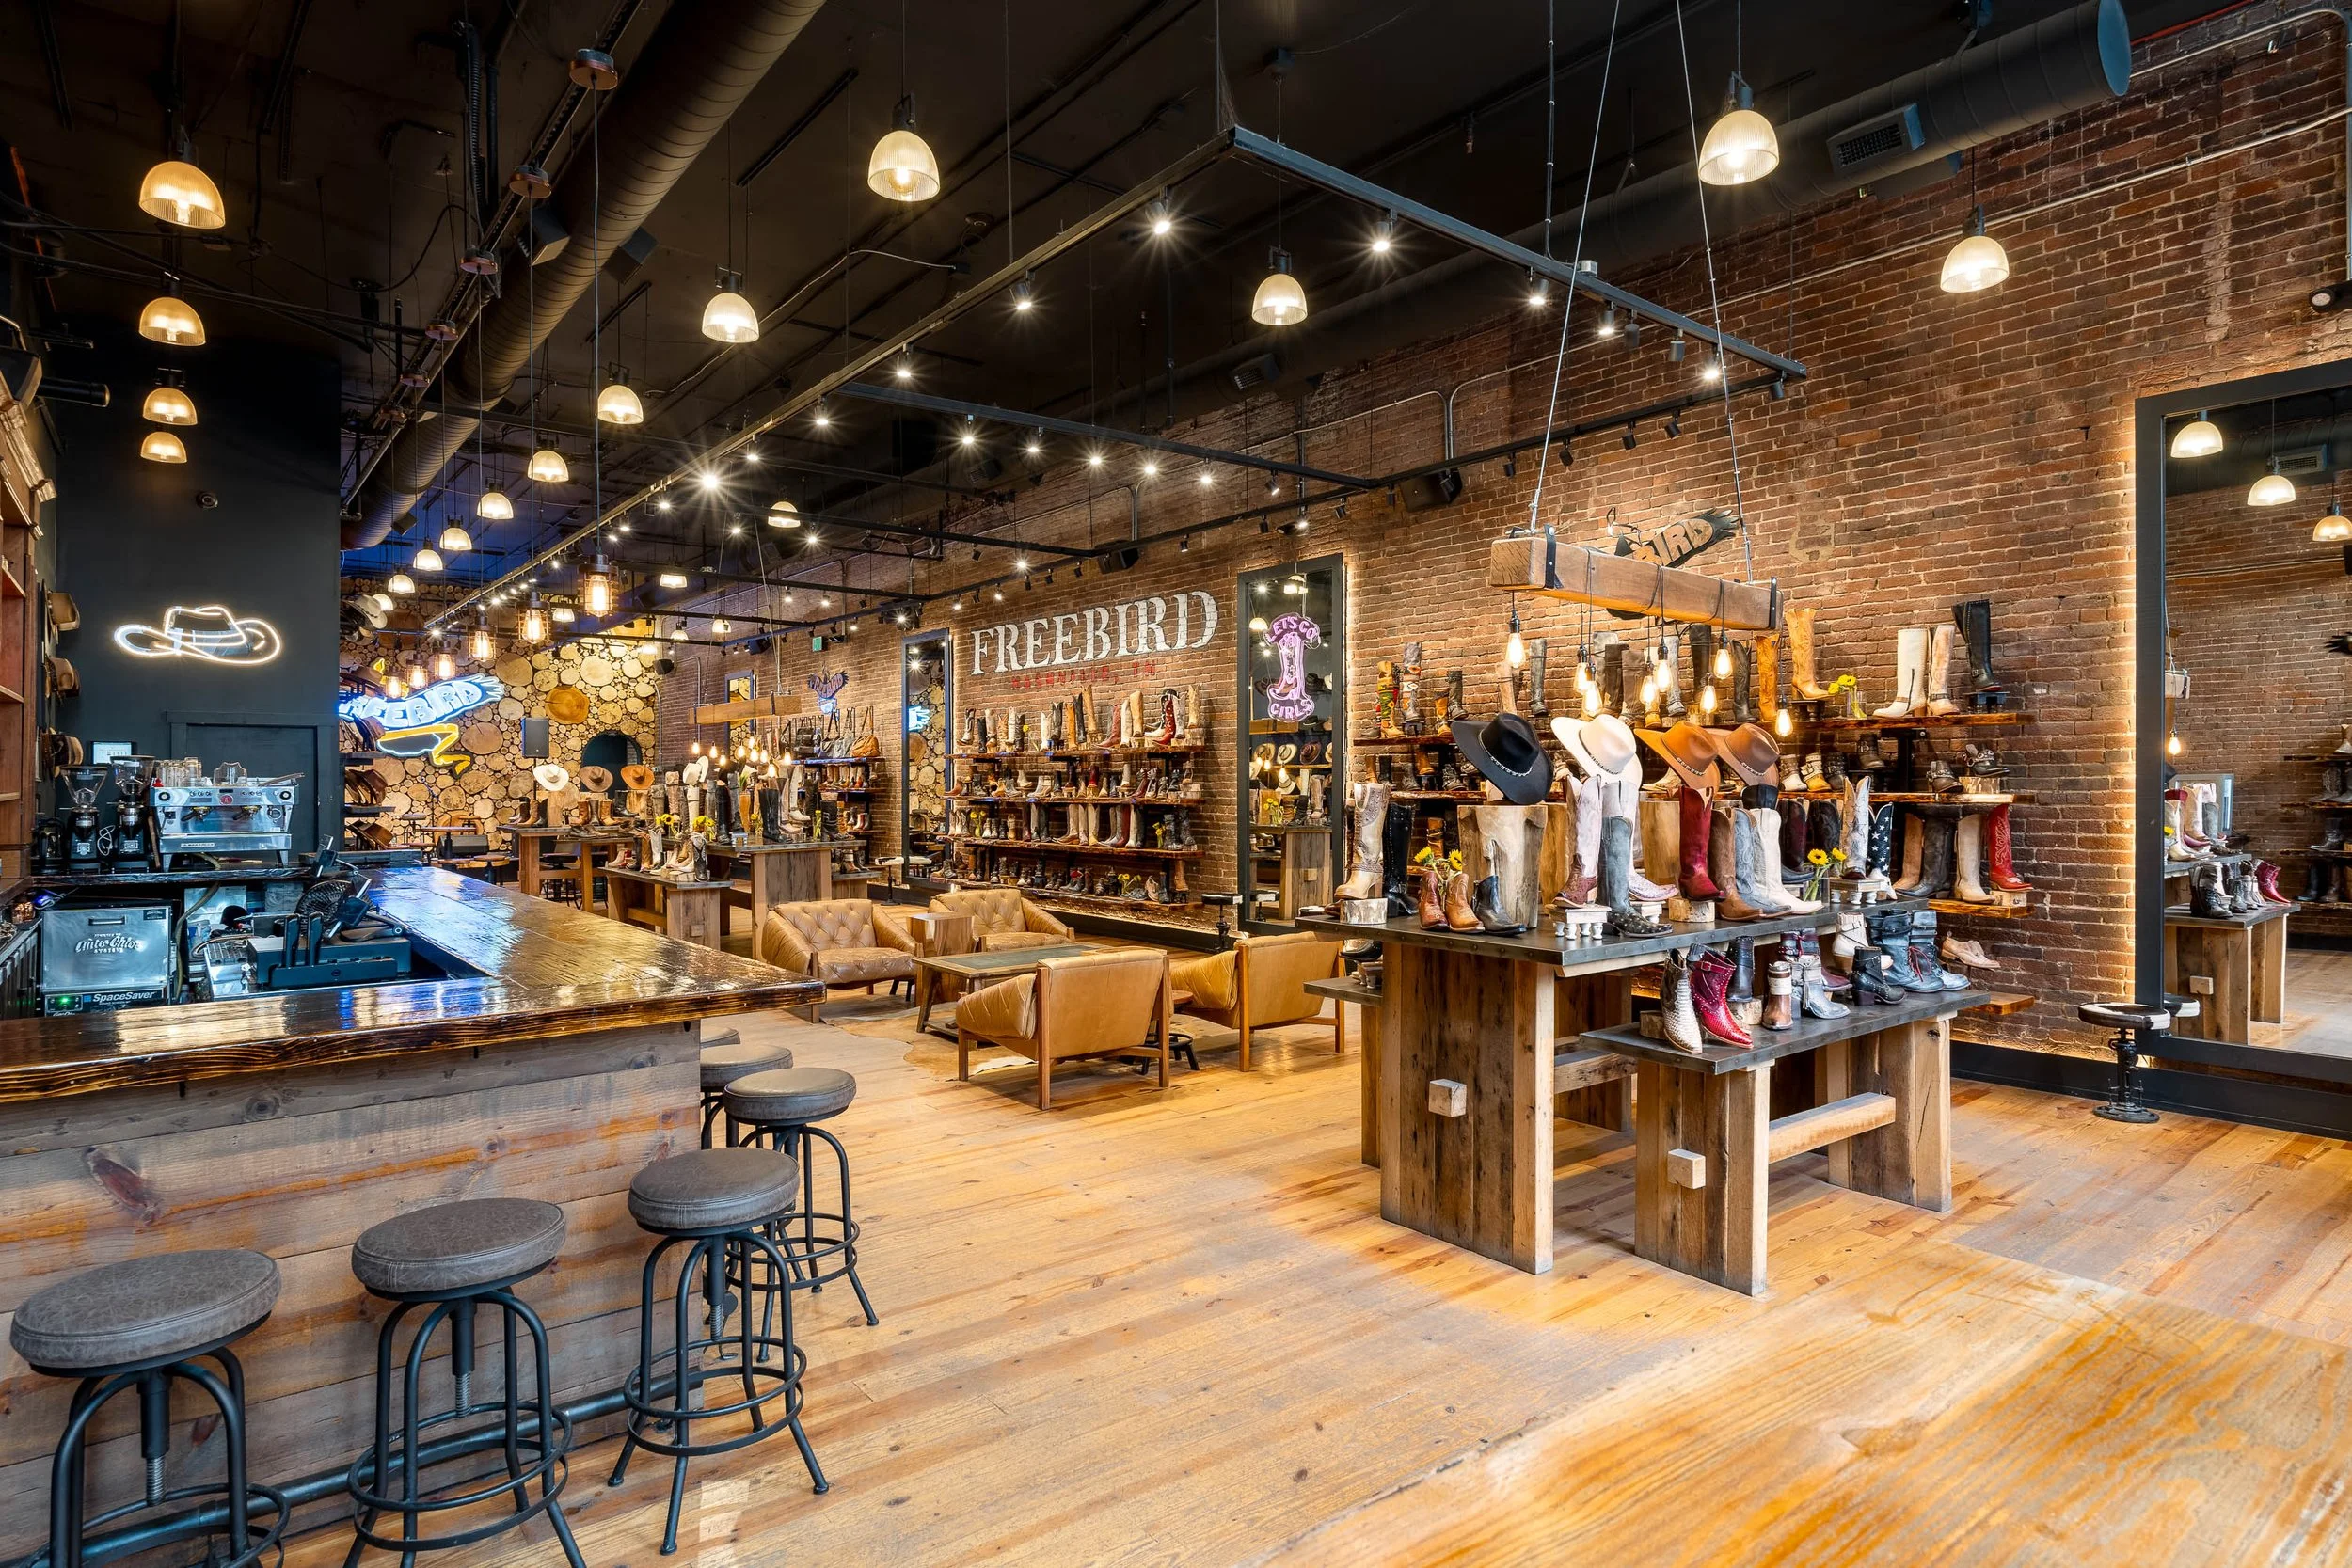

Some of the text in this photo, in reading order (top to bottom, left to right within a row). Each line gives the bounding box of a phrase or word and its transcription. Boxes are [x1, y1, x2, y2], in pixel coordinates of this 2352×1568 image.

[971, 591, 1218, 675] FREEBIRD
[1265, 616, 1298, 642] LET'S
[1270, 699, 1311, 721] GIRLS
[75, 936, 147, 953] Auto-Chlo
[92, 990, 154, 1003] SpaceSaver
